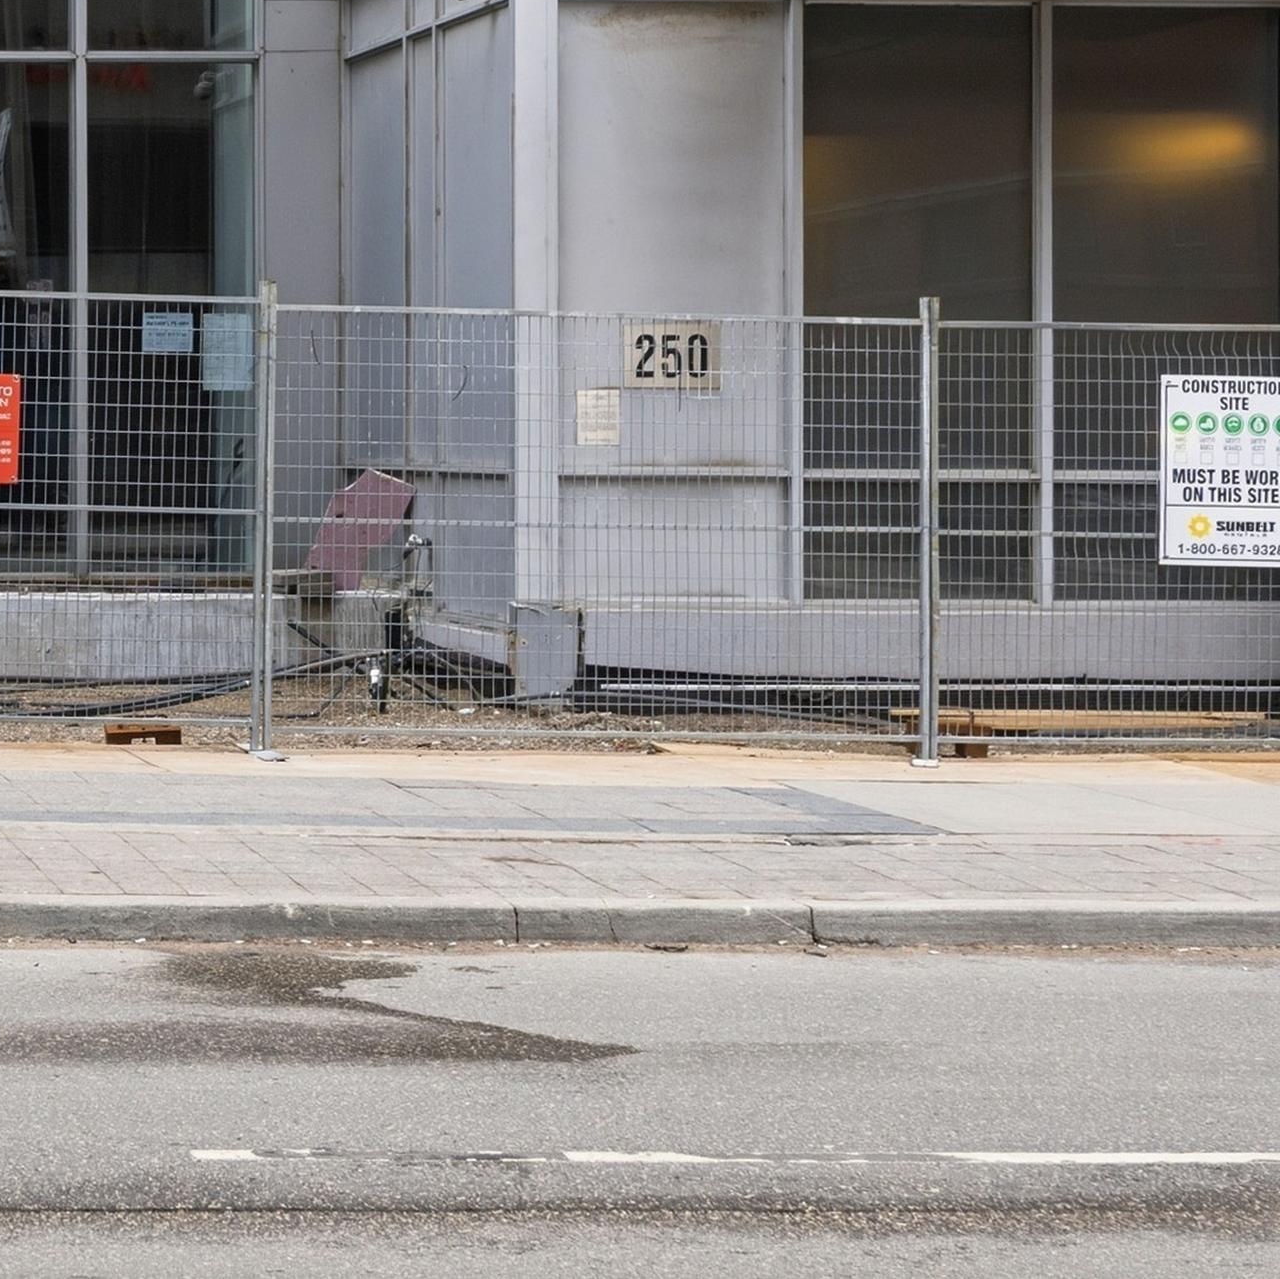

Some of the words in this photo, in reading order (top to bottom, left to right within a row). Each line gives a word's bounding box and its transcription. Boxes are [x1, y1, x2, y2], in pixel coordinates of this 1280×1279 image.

[634, 333, 709, 379] 250
[1181, 378, 1280, 396] CONSTRUCTIO
[1219, 396, 1250, 411] SITE
[1172, 468, 1216, 485] MUST
[1221, 469, 1241, 486] BE
[1182, 486, 1204, 503] ON
[1208, 487, 1242, 503] THIS
[1247, 488, 1280, 504] SITE
[1216, 520, 1277, 533] SUNBELT
